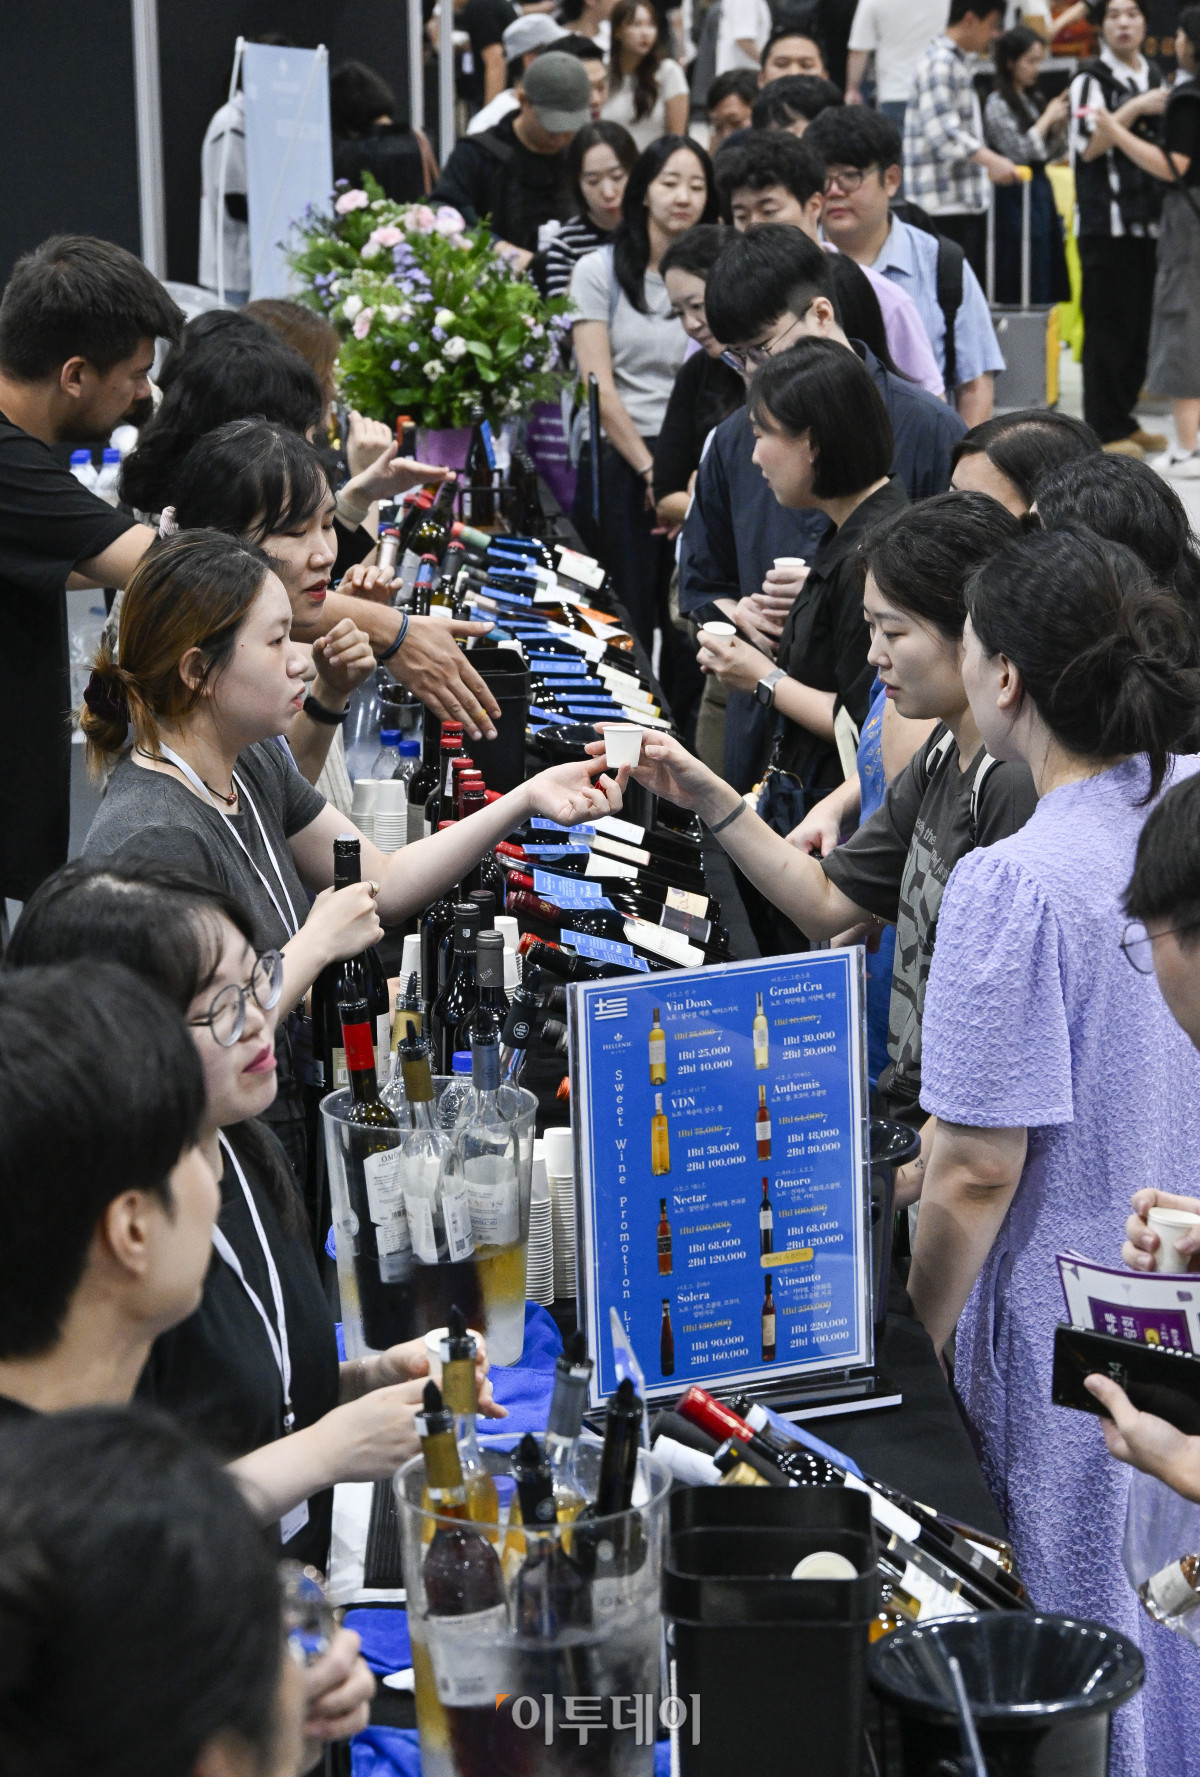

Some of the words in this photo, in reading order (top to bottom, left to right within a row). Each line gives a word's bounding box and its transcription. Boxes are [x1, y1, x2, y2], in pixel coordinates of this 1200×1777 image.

[769, 982, 801, 997] Grand
[803, 981, 822, 992] Cru
[666, 1001, 684, 1012] Vin
[685, 998, 712, 1009] Doux
[602, 1041, 632, 1050] HELLENIC
[783, 1035, 800, 1046] 1Btl
[802, 1030, 836, 1043] 30,000
[678, 1050, 695, 1060] 1Btl
[697, 1045, 731, 1058] 25,000
[782, 1049, 801, 1060] 2Btl
[803, 1044, 837, 1057] 50,000
[678, 1064, 696, 1075] 2Btl
[699, 1059, 733, 1072] 40,000
[772, 1079, 820, 1094] Anthemis
[615, 1069, 625, 1127] Sweet
[671, 1096, 696, 1109] VDN
[787, 1133, 804, 1144] 1Btl
[807, 1127, 840, 1140] 48,000
[687, 1147, 704, 1158] 1Btl
[706, 1142, 740, 1155] 58,000
[786, 1146, 805, 1158] 2Btl
[807, 1142, 841, 1154] 80,000
[615, 1138, 628, 1184] Wine
[686, 1161, 705, 1172] 2Btl
[708, 1155, 746, 1169] 100,000
[775, 1177, 811, 1189] Omoro
[673, 1194, 708, 1206] Nectar
[787, 1226, 804, 1237] 1Btl
[806, 1220, 839, 1233] 68,000
[620, 1196, 631, 1299] Promotion
[689, 1243, 705, 1254] 1Btl
[707, 1237, 741, 1250] 68,000
[786, 1239, 805, 1251] 2Btl
[807, 1233, 844, 1247] 120,000
[688, 1257, 707, 1268] 2Btl
[709, 1251, 747, 1265] 120,000
[777, 1273, 821, 1287] Vinsanto
[677, 1291, 710, 1304] Solera
[791, 1324, 808, 1335] 1Btl
[810, 1317, 848, 1331] 220,000
[1121, 1315, 1138, 1339] 람회
[691, 1340, 708, 1351] 1Btl
[710, 1335, 744, 1347] 90,000
[790, 1337, 808, 1349] 2Btl
[812, 1330, 849, 1344] 400,000
[690, 1354, 709, 1365] 2Btl
[712, 1347, 749, 1362] 160,000
